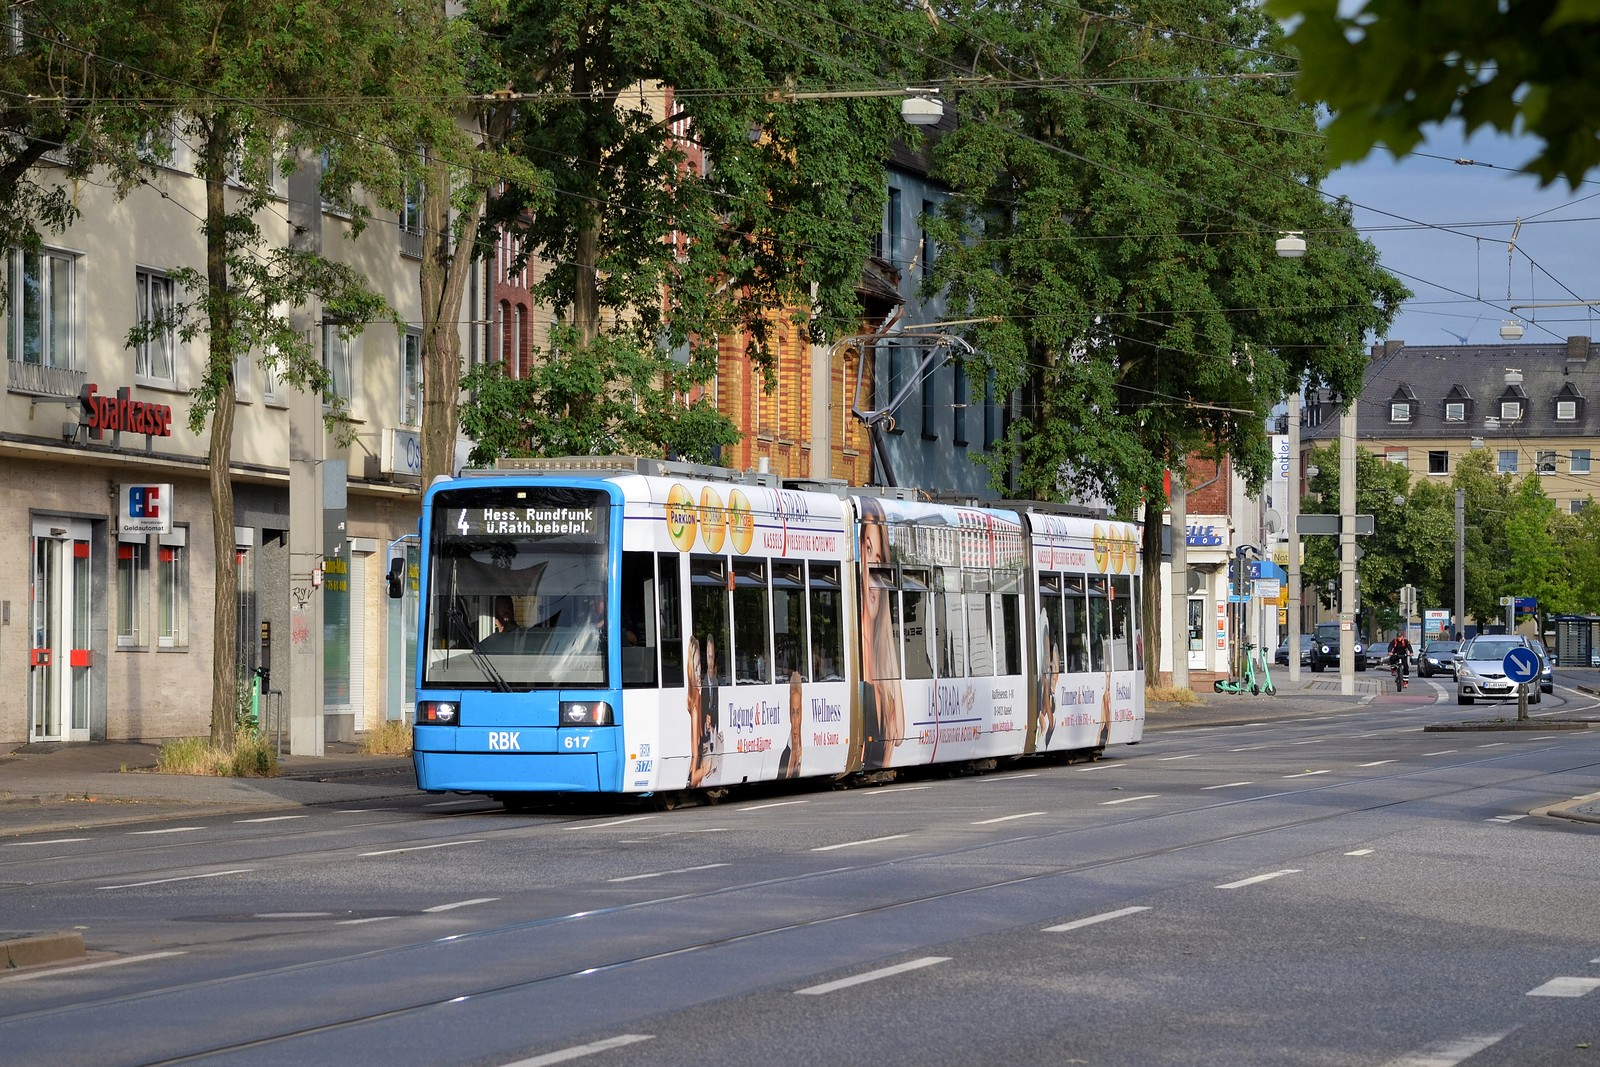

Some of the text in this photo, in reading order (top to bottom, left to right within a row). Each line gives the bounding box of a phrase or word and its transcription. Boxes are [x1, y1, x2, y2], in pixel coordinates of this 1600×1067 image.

[87, 383, 171, 440] Sparkasse
[406, 437, 420, 469] Os
[457, 508, 470, 535] 4
[483, 508, 593, 520] Hess. Rundfunk
[1186, 525, 1218, 537] ELLE.
[811, 698, 841, 723] Wellness
[937, 685, 961, 716] STRADA
[728, 700, 780, 734] Tagung & Event
[488, 731, 520, 751] RBK
[564, 736, 590, 749] 617
